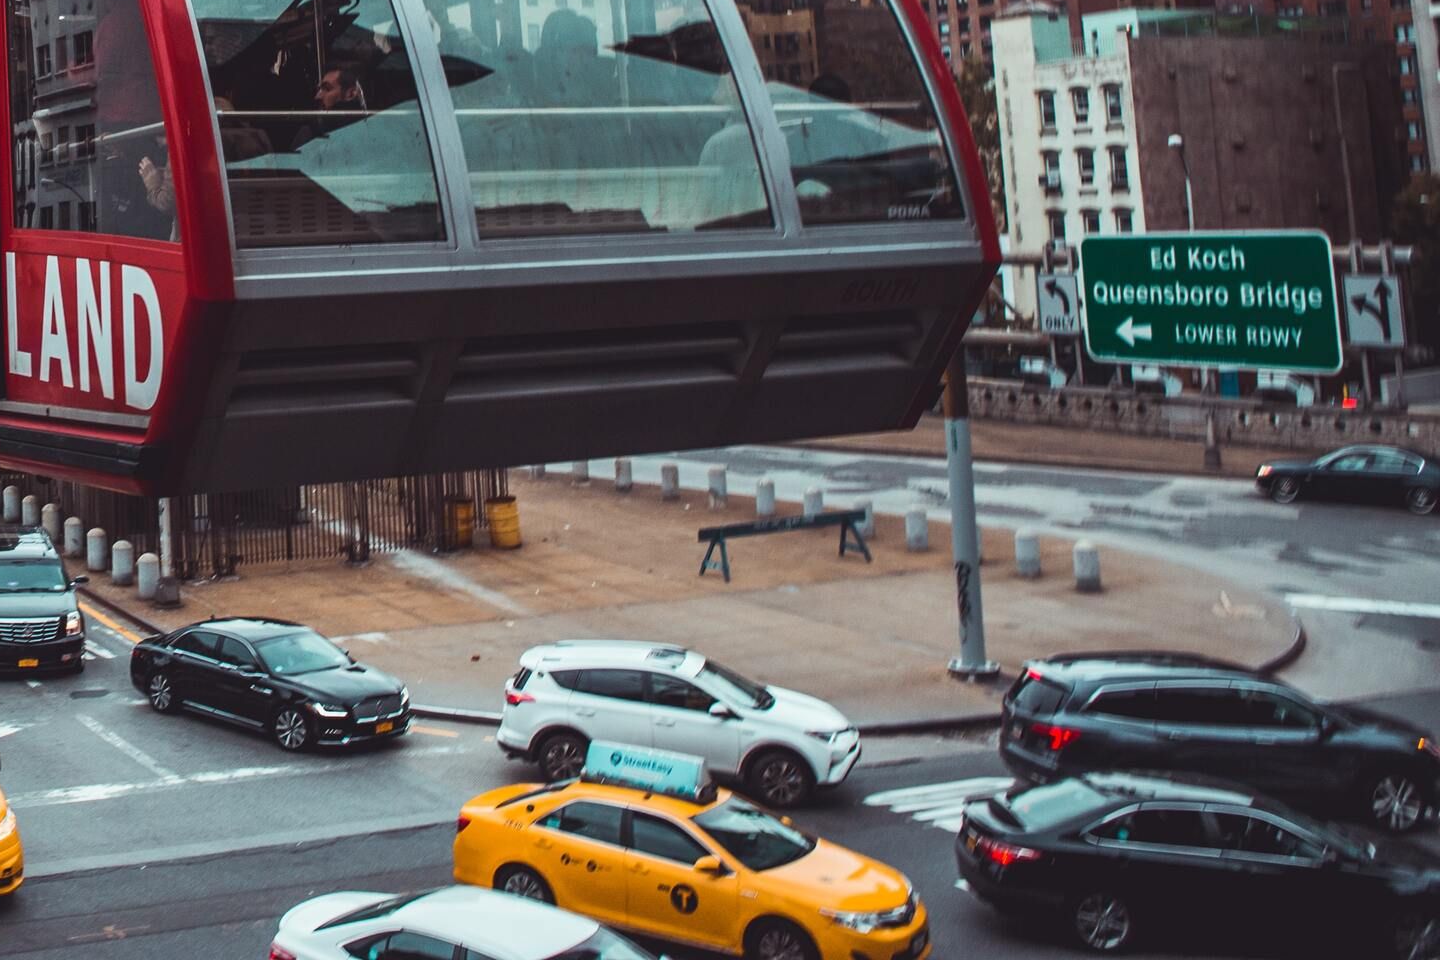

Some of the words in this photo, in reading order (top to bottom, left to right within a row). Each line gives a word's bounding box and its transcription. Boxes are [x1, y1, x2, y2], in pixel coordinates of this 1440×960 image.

[888, 204, 930, 219] POMA
[1150, 247, 1176, 270] Ed
[1188, 245, 1246, 270] Koch
[1093, 280, 1229, 307] Queensboro
[1240, 282, 1323, 314] Bridge
[1045, 315, 1075, 331] ONLY
[1175, 323, 1237, 346] LOWER
[1247, 326, 1303, 349] RDWY
[624, 755, 674, 776] StreetEasy
